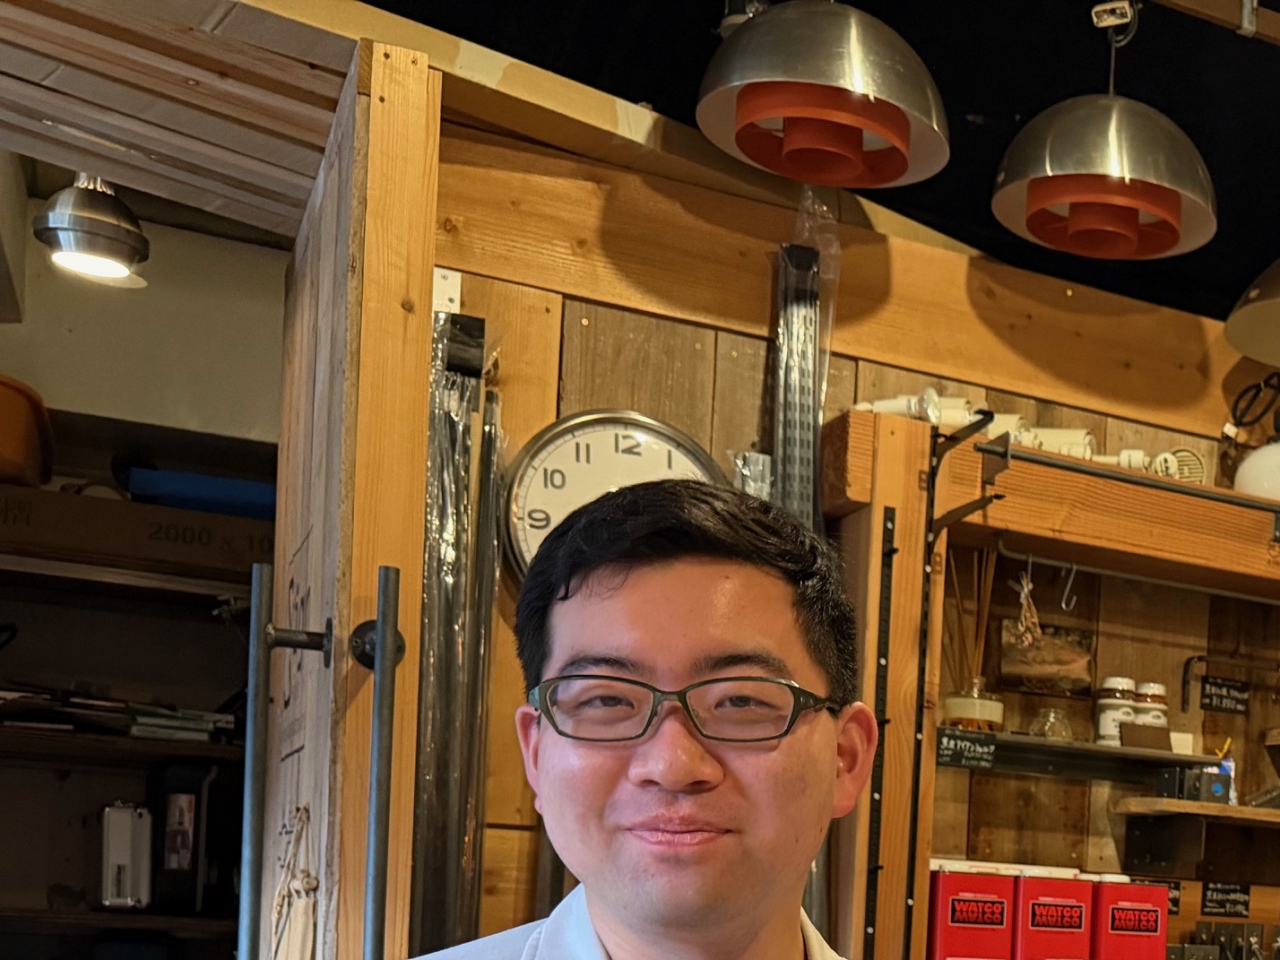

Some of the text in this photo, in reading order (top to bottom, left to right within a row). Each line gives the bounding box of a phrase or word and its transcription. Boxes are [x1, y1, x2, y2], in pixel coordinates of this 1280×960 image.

[575, 442, 591, 464] 11
[614, 433, 642, 456] 12
[667, 449, 673, 470] 1
[543, 468, 567, 490] 10
[527, 509, 552, 530] 9
[148, 522, 212, 546] 2000
[953, 900, 1002, 914] WATCO
[1034, 904, 1081, 918] WATCO
[1113, 909, 1157, 922] WATCO
